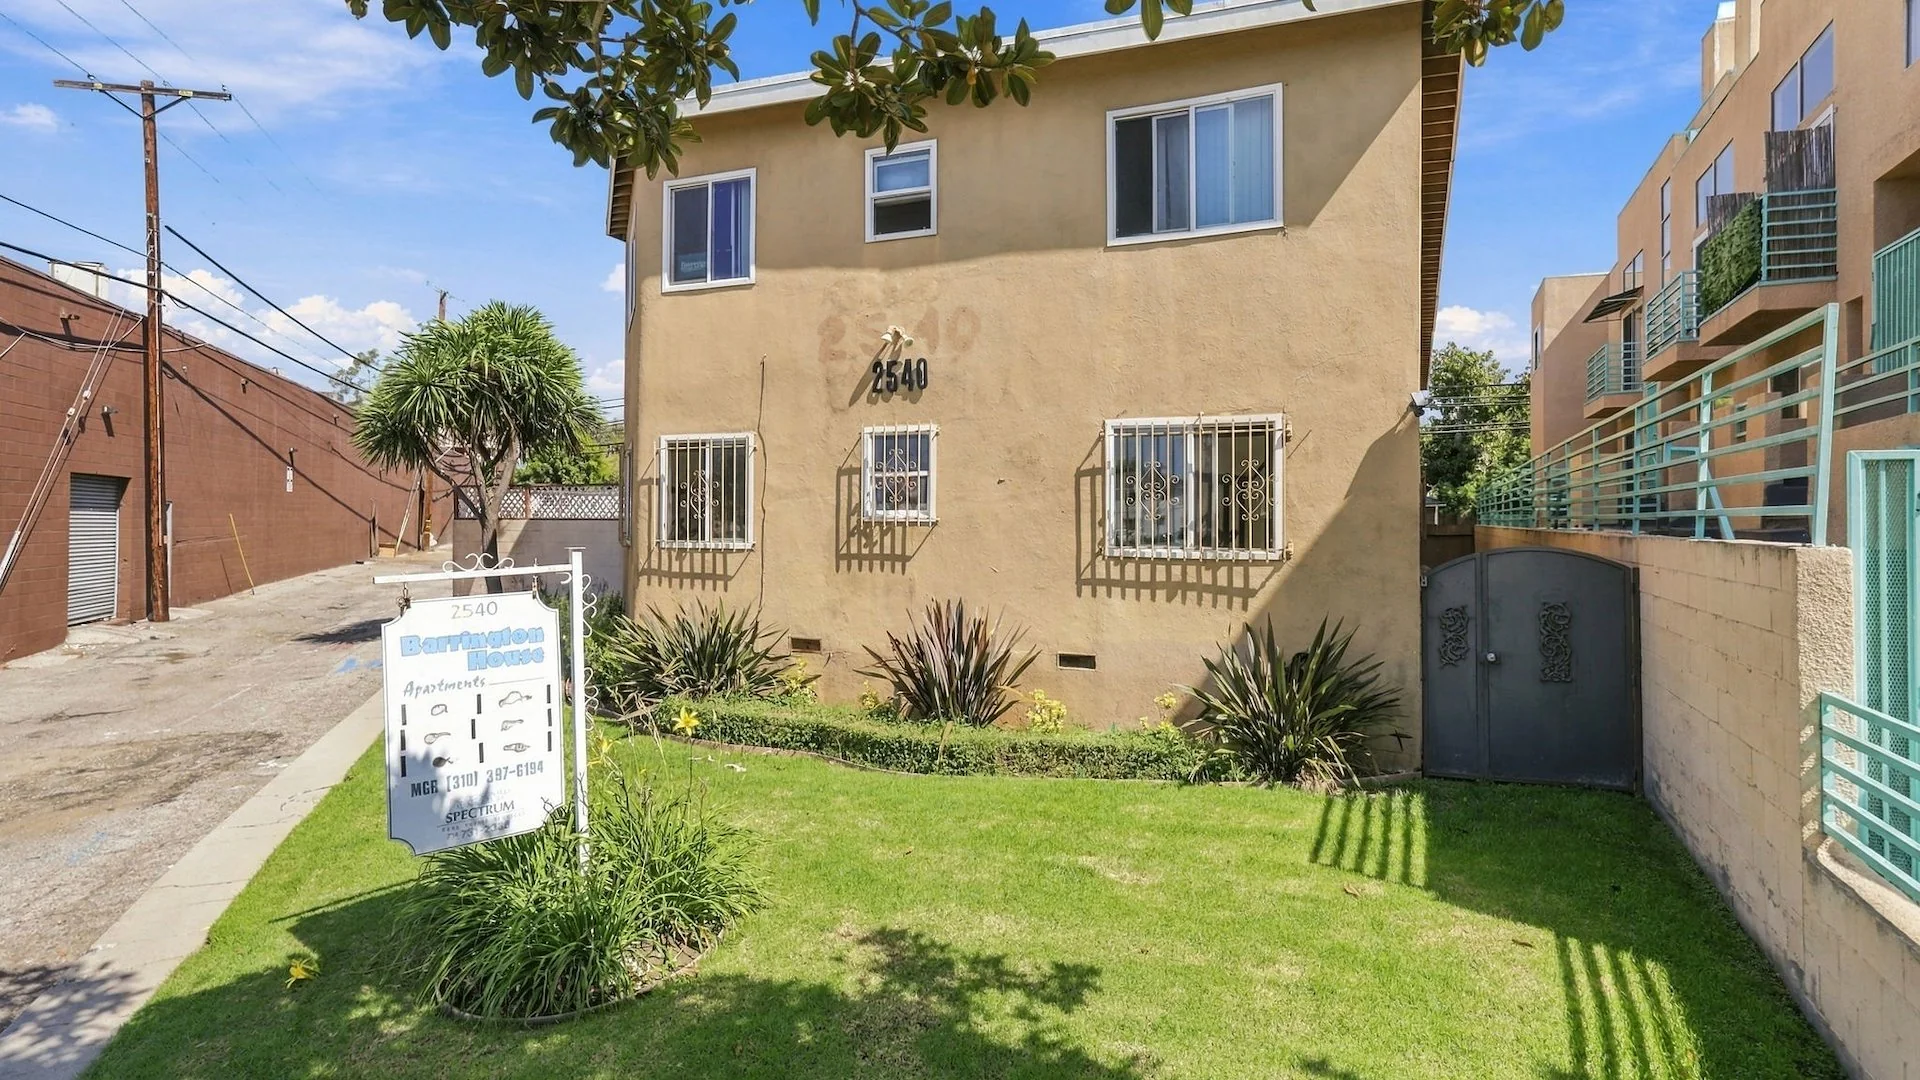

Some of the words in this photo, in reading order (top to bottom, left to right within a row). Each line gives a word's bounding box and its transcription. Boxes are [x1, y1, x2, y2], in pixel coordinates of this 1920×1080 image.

[872, 357, 929, 393] 2540
[451, 601, 498, 619] 2540
[400, 626, 545, 657] Barrington
[467, 647, 545, 671] House
[403, 675, 486, 698] Apartments
[410, 779, 438, 798] MGR
[486, 760, 544, 783] 397-6194
[445, 800, 515, 824] SPECTRUM
